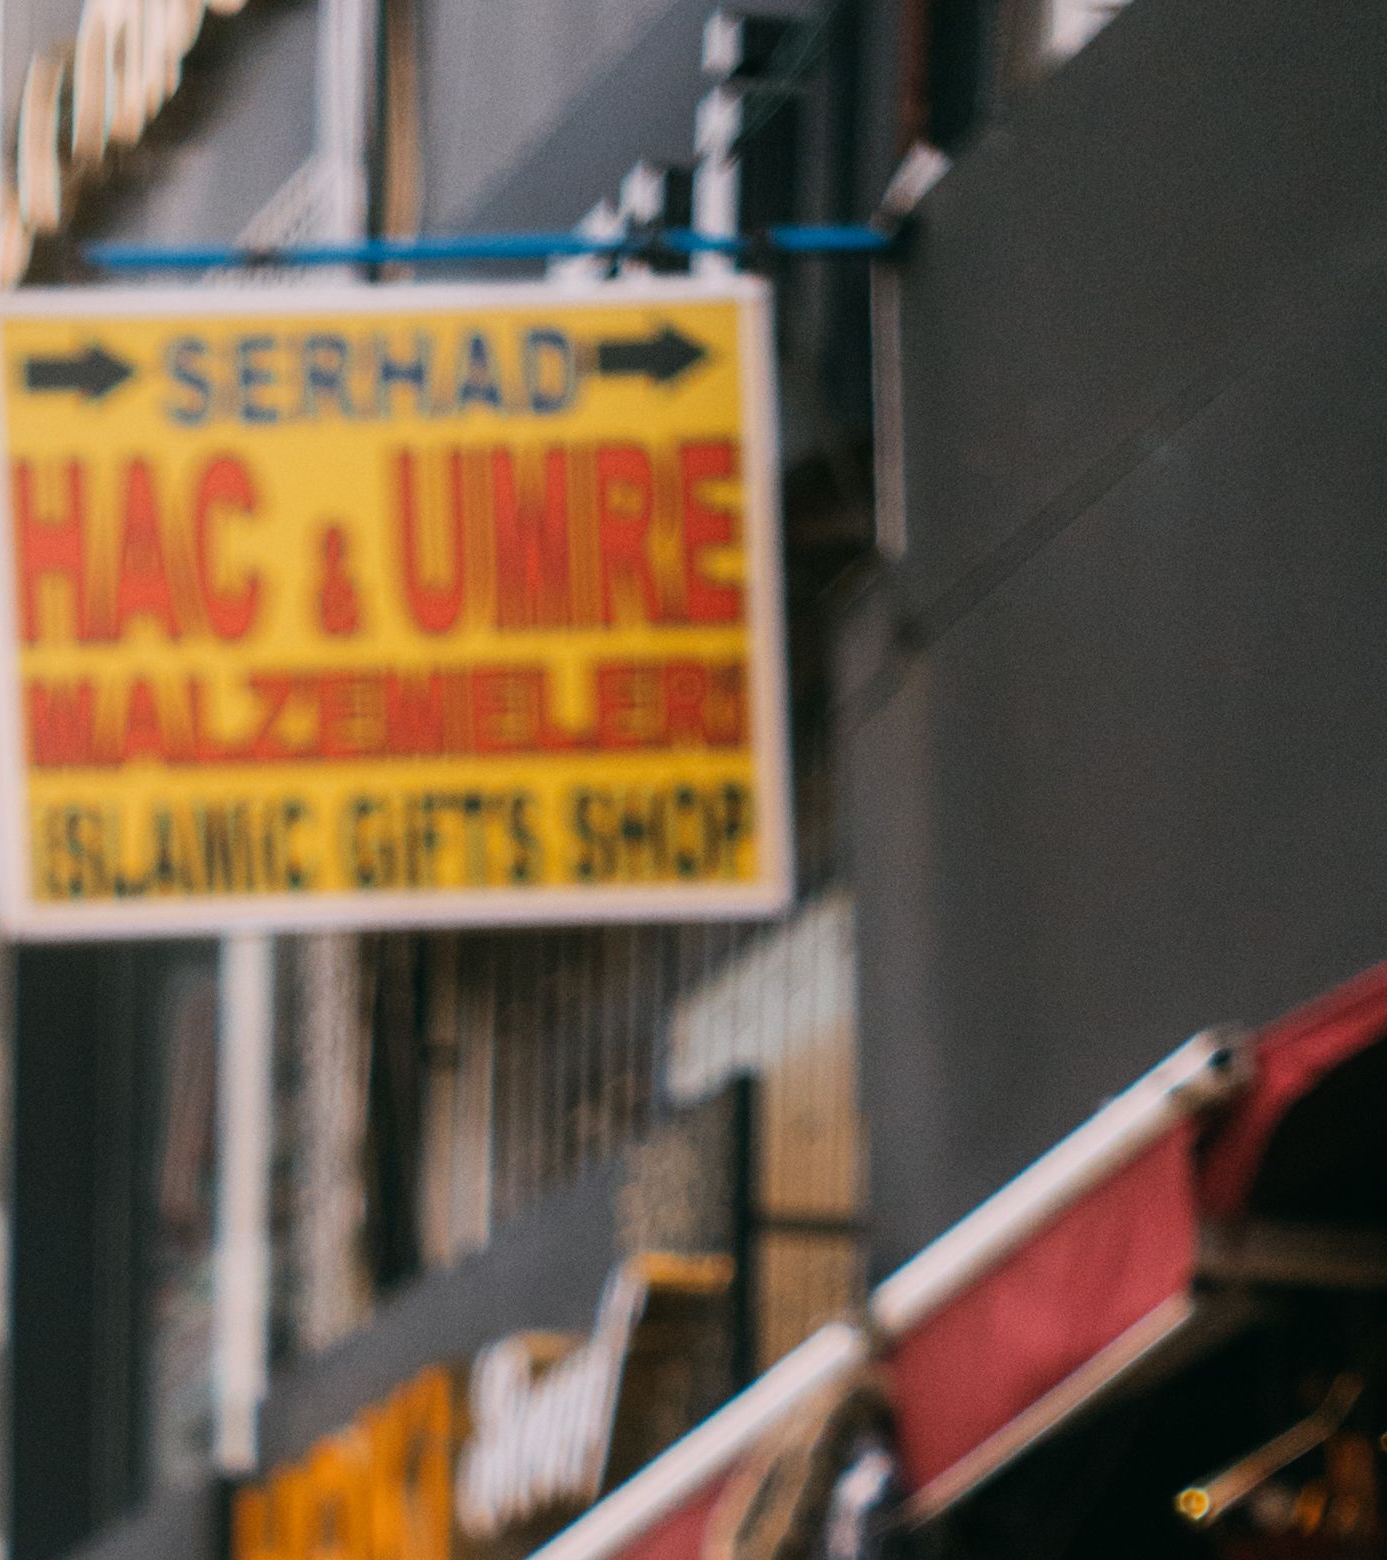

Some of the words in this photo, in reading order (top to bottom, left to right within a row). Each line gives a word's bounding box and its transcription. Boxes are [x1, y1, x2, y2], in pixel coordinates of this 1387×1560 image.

[165, 330, 579, 424] SERHAD
[15, 455, 260, 645] HAC
[316, 522, 361, 637] &
[395, 442, 742, 634] UMRE
[37, 798, 307, 897] ISLAMIC
[343, 790, 537, 888] GIFTS
[577, 784, 749, 880] SHOP
